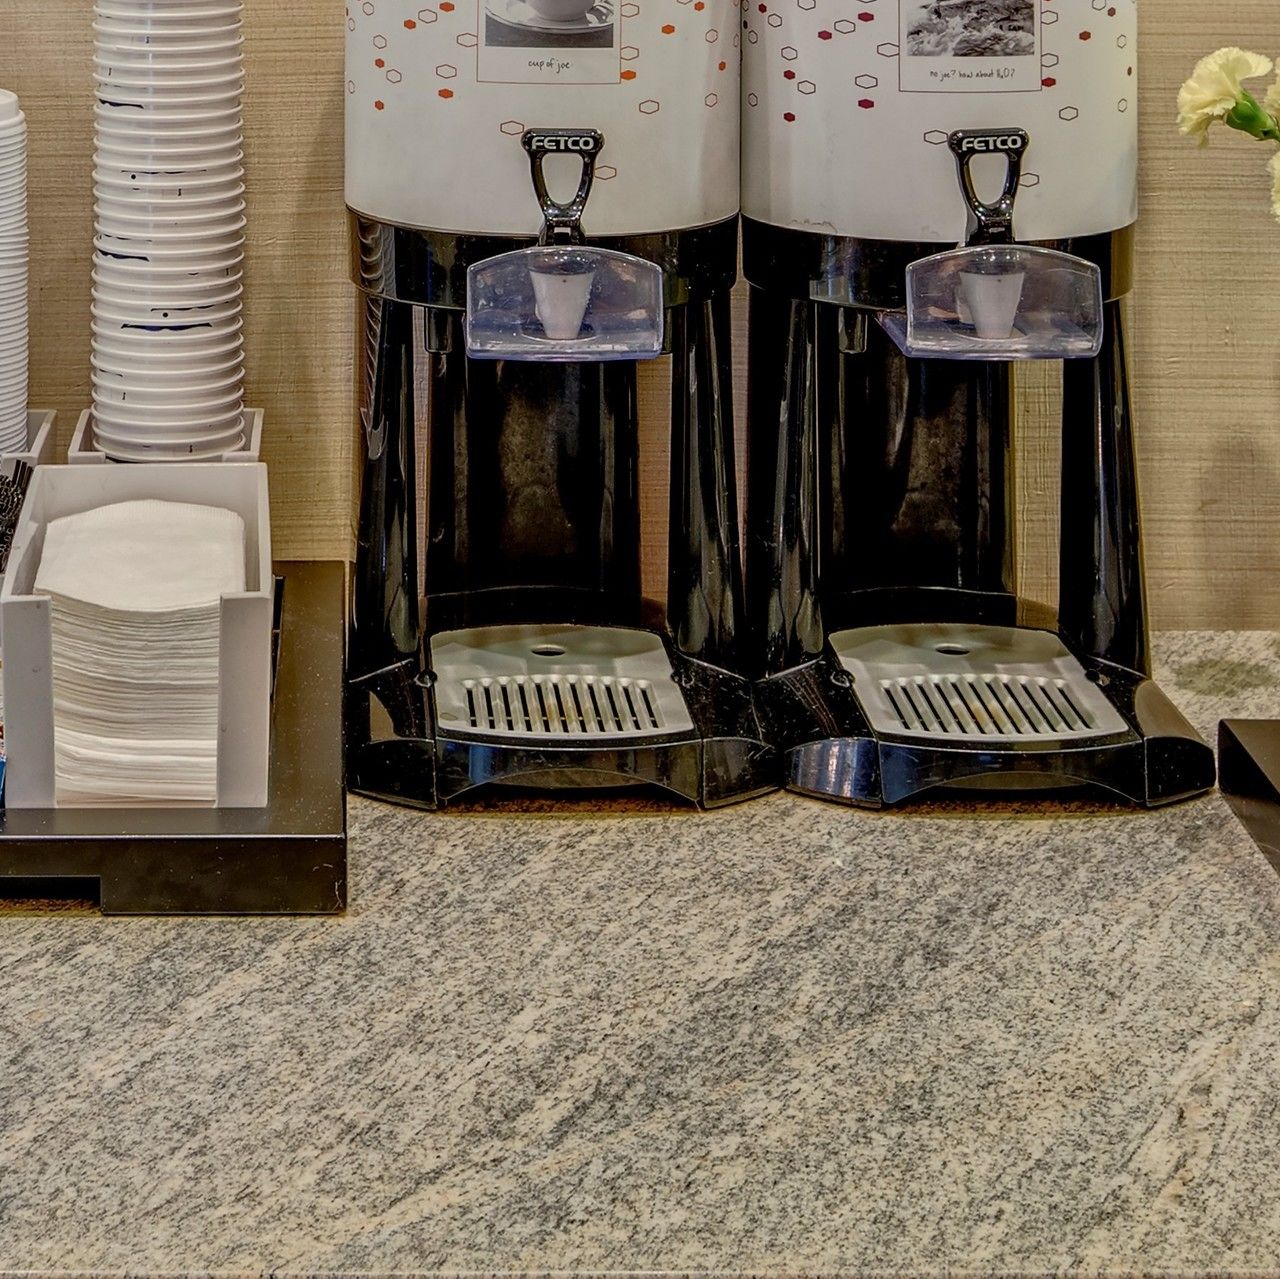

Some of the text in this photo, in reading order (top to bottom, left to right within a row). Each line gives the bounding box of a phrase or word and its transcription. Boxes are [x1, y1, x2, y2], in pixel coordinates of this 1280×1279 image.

[528, 57, 570, 74] cup of joe
[930, 70, 938, 78] no
[939, 69, 956, 82] joe?
[958, 70, 973, 78] how
[531, 136, 595, 150] FETCO
[961, 135, 1022, 151] FETCO
